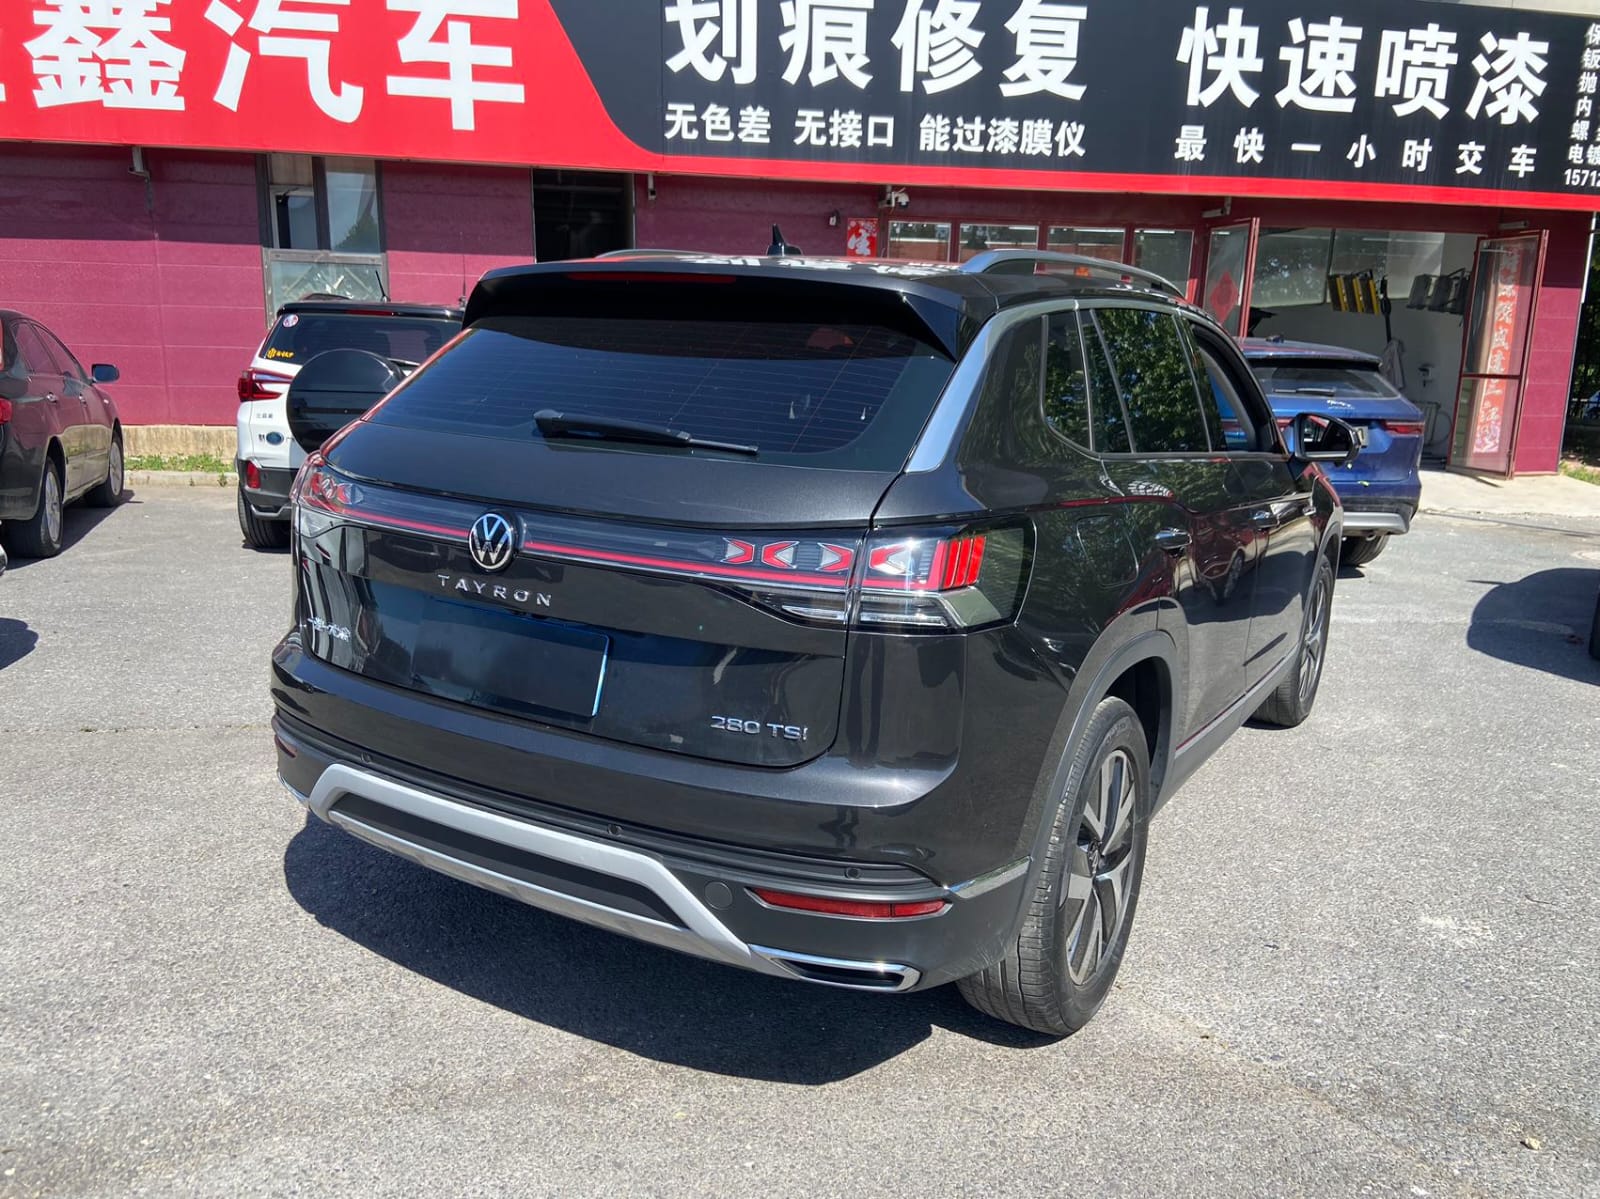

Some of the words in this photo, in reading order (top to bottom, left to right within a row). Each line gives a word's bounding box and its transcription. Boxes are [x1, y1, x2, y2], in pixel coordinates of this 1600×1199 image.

[0, 0, 525, 131] 鑫汽车
[665, 0, 1088, 100] 划痕修复
[1176, 6, 1550, 125] 快速喷漆
[664, 103, 771, 144] 无色差
[793, 109, 894, 148] 无接口
[919, 113, 1086, 157] 能过漆膜仪
[1174, 124, 1537, 178] 最快一小时交车
[437, 574, 552, 607] TAYRON
[710, 715, 760, 734] 280
